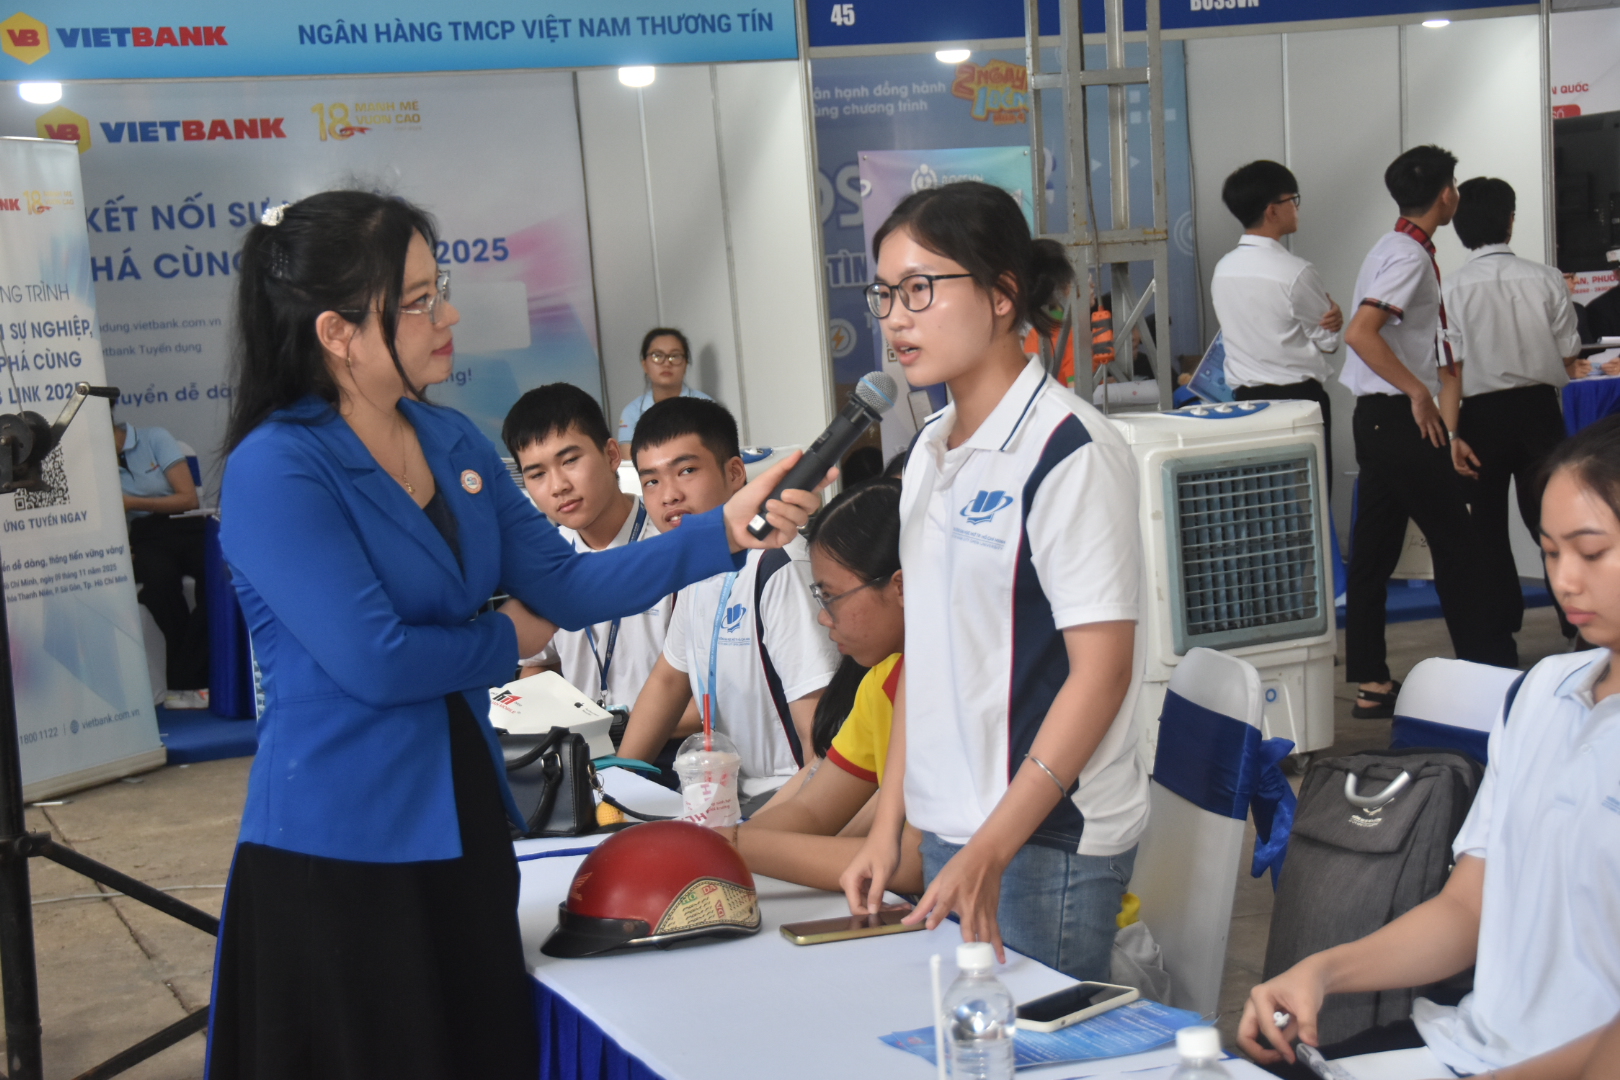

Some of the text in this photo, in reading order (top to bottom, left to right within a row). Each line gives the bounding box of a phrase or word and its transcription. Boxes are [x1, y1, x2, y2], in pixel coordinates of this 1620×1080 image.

[298, 8, 773, 45] NGÂN HÀNG TMCP VIỆT NAM THƯƠNG TÍN
[830, 4, 855, 26] 45
[7, 26, 229, 48] VB VIETBANK
[813, 85, 831, 100] ân
[834, 84, 869, 101] hạnh
[912, 81, 946, 95] hành
[1560, 81, 1589, 94] QUỐC
[395, 113, 421, 124] CAO
[814, 103, 839, 119] ùng
[100, 118, 287, 143] VIETBANK
[86, 194, 138, 232] KẾT
[152, 192, 216, 231] NỐI
[91, 247, 142, 282] HÁ
[436, 237, 509, 264] 2025
[0, 280, 71, 304] NG TRÌNH
[10, 319, 27, 344] SỰ
[31, 314, 93, 341] NGHIỆP,
[34, 347, 82, 371] CÙNG
[8, 384, 42, 404] LINK
[117, 382, 168, 407] uyển
[175, 382, 199, 400] dễ
[3, 517, 26, 533] ỨNG
[61, 510, 87, 525] NGAY
[19, 731, 38, 745] 1800
[39, 726, 59, 740] 1122
